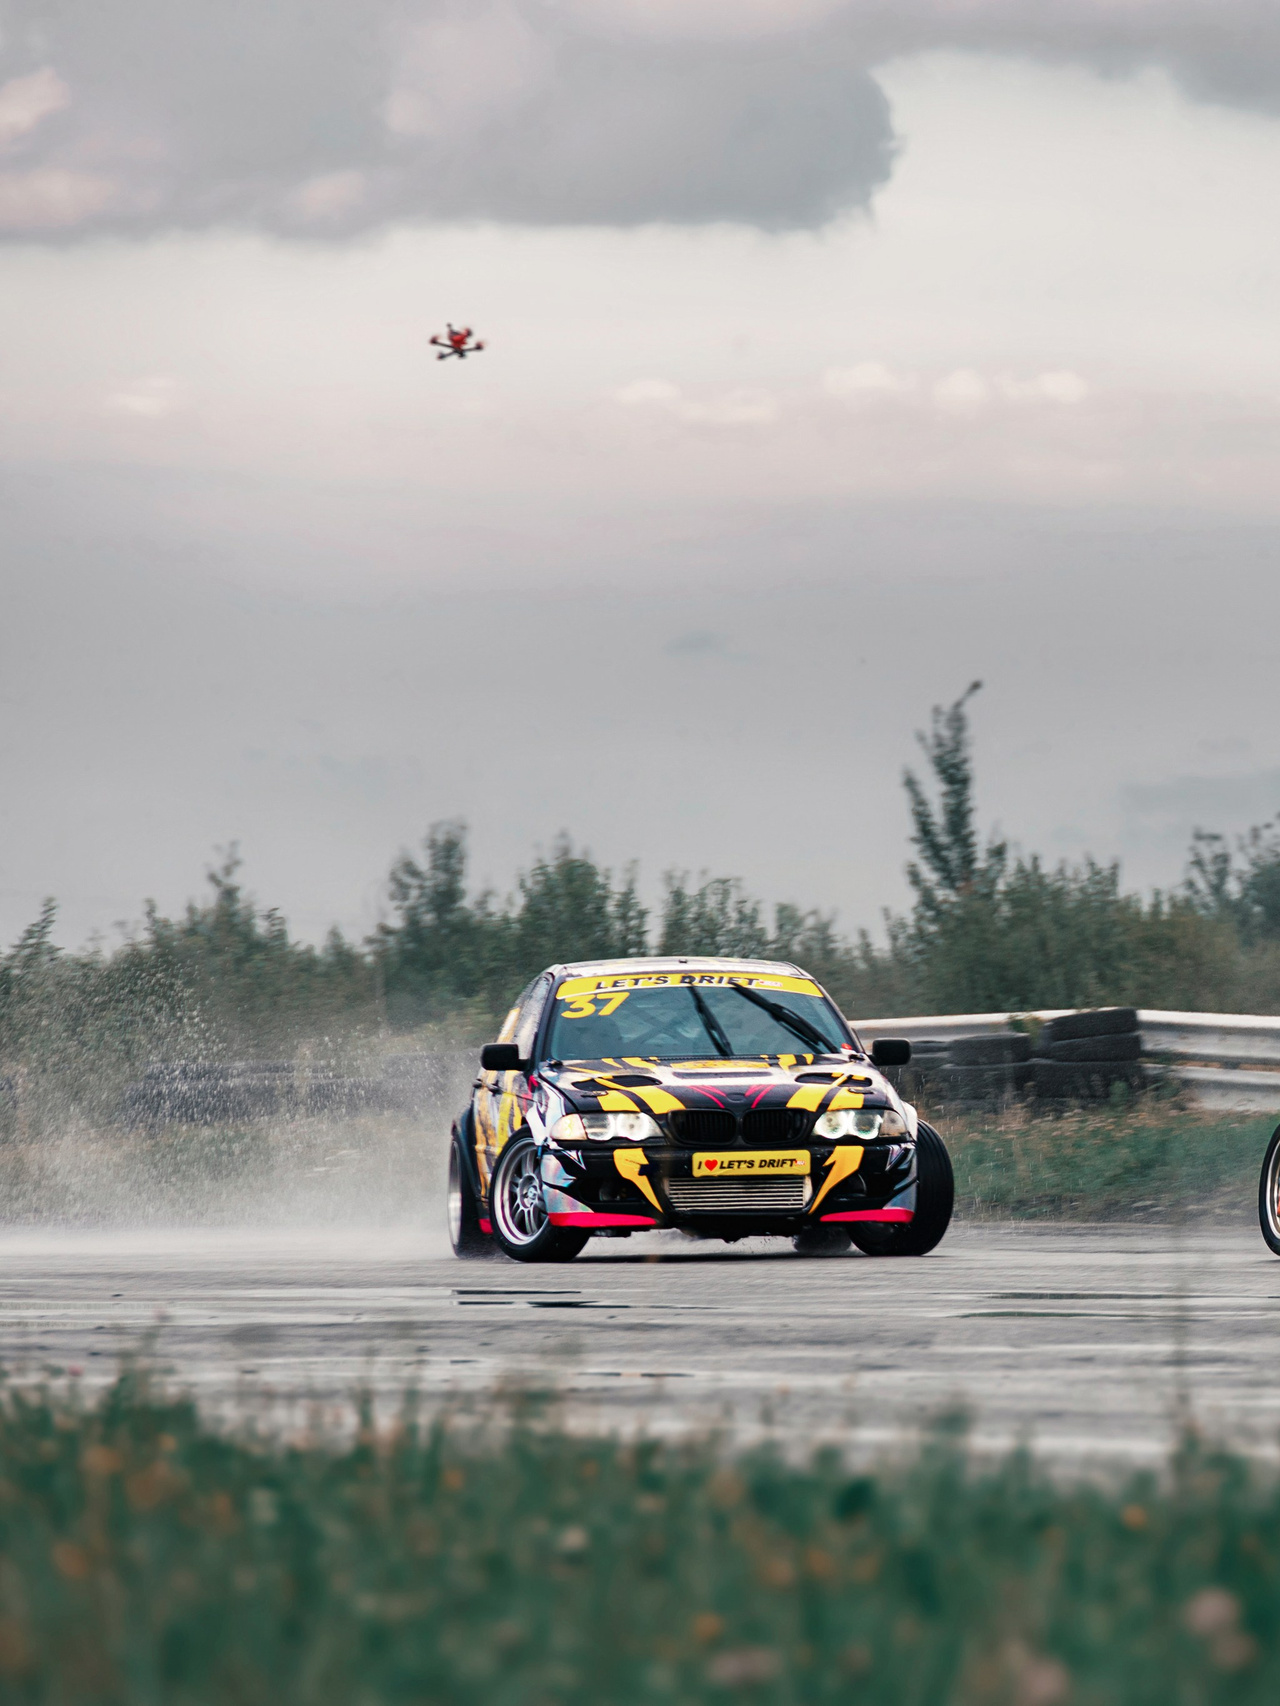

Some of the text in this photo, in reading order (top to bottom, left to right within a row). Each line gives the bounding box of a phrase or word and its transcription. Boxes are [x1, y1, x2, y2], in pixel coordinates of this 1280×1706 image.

[595, 975, 669, 990] LET'S
[560, 992, 631, 1019] 37
[697, 1161, 702, 1170] I
[719, 1160, 755, 1170] LET'S
